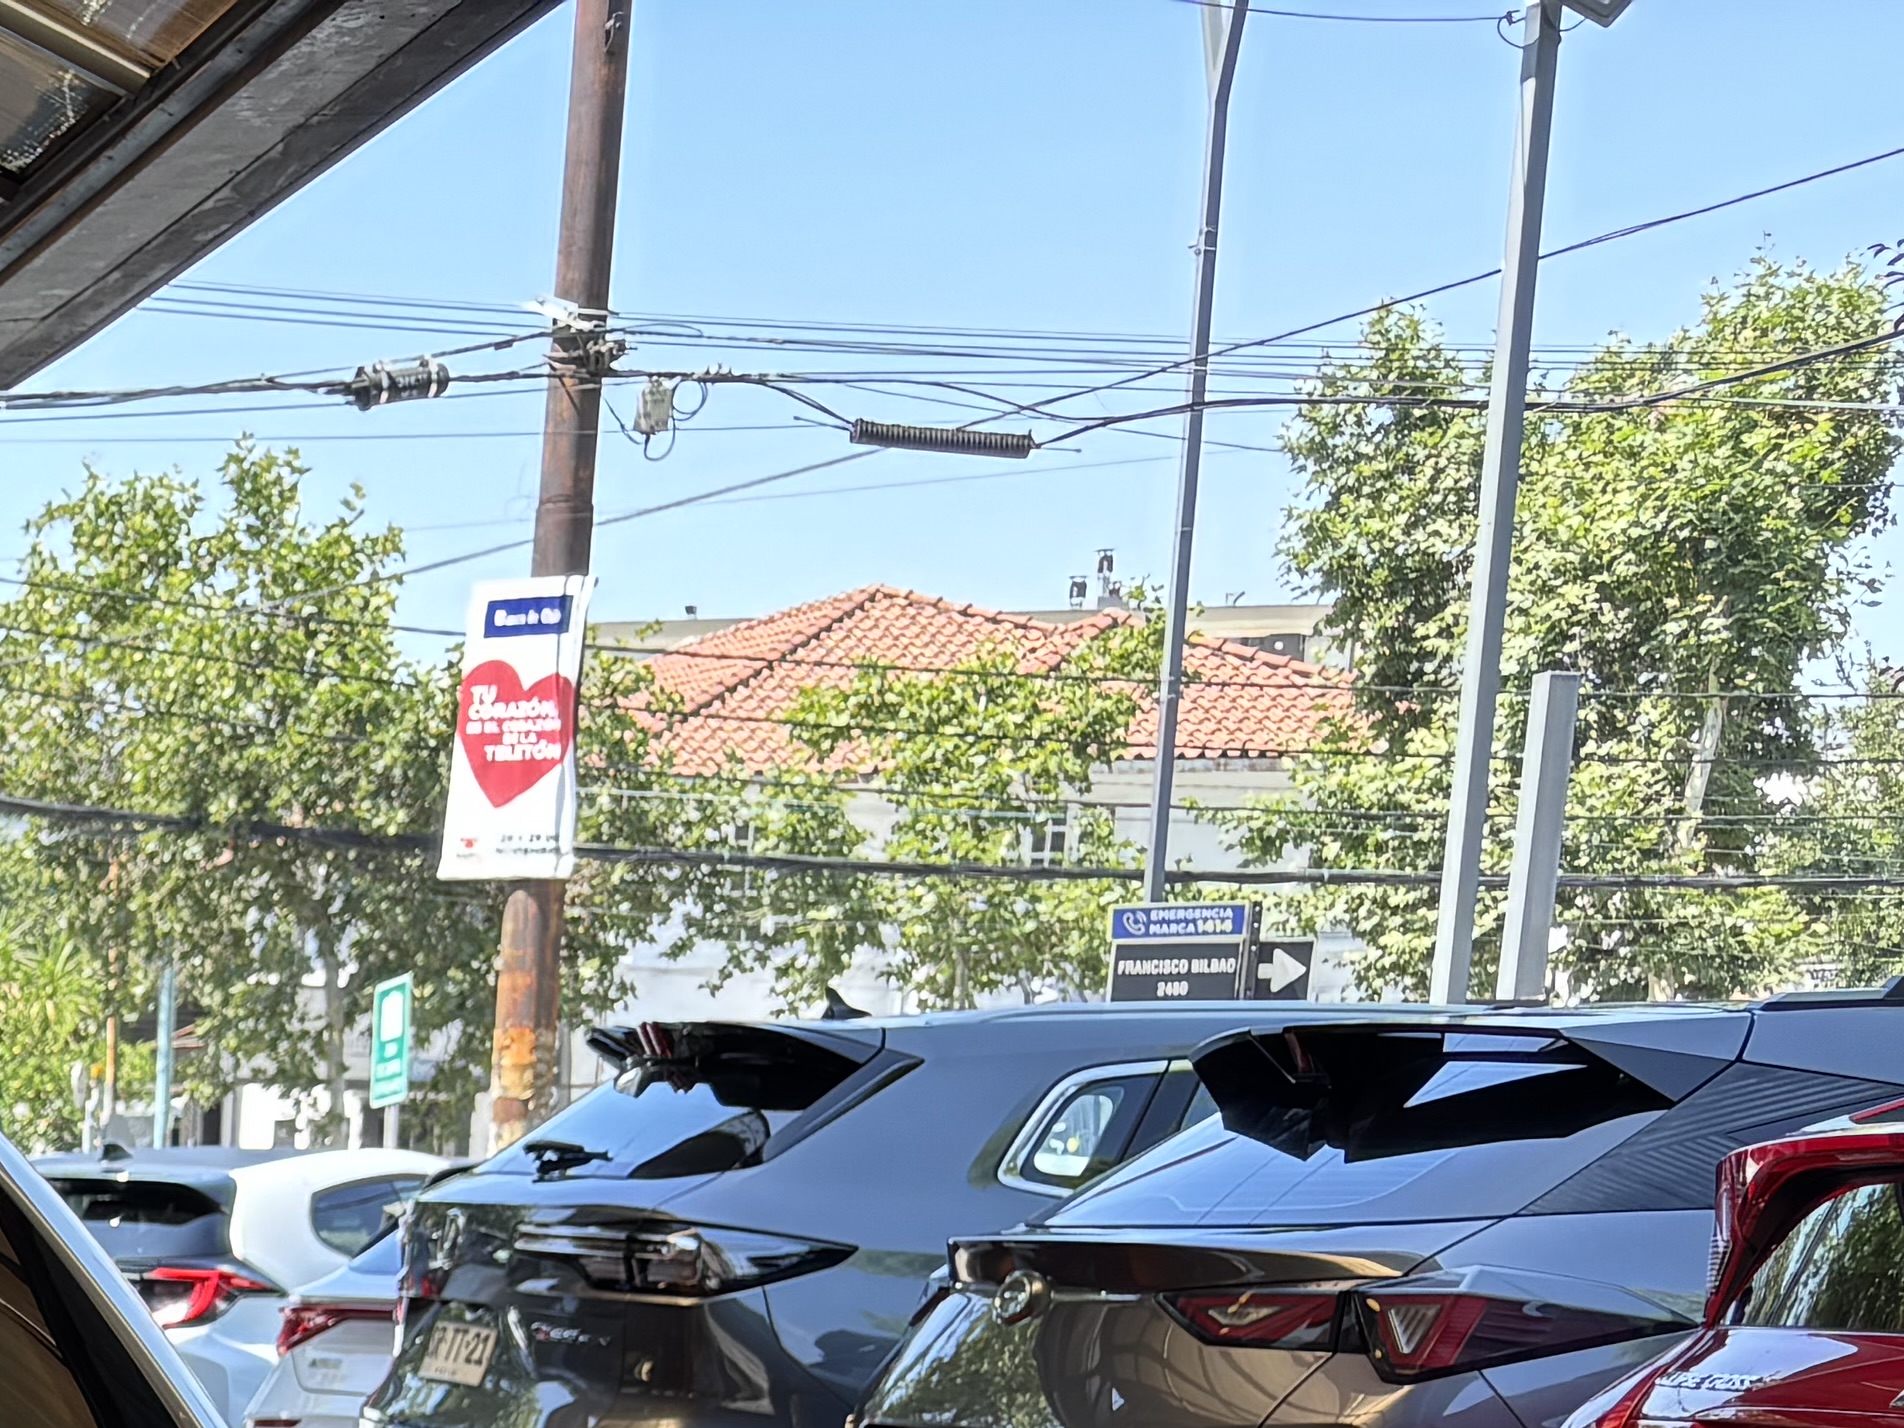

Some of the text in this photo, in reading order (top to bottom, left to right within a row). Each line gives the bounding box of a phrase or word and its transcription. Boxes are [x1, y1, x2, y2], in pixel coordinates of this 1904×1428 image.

[1150, 908, 1233, 921] EMERGENCIA
[1149, 923, 1195, 935] MARCA
[1117, 958, 1236, 975] FRANCISCO BILBAO
